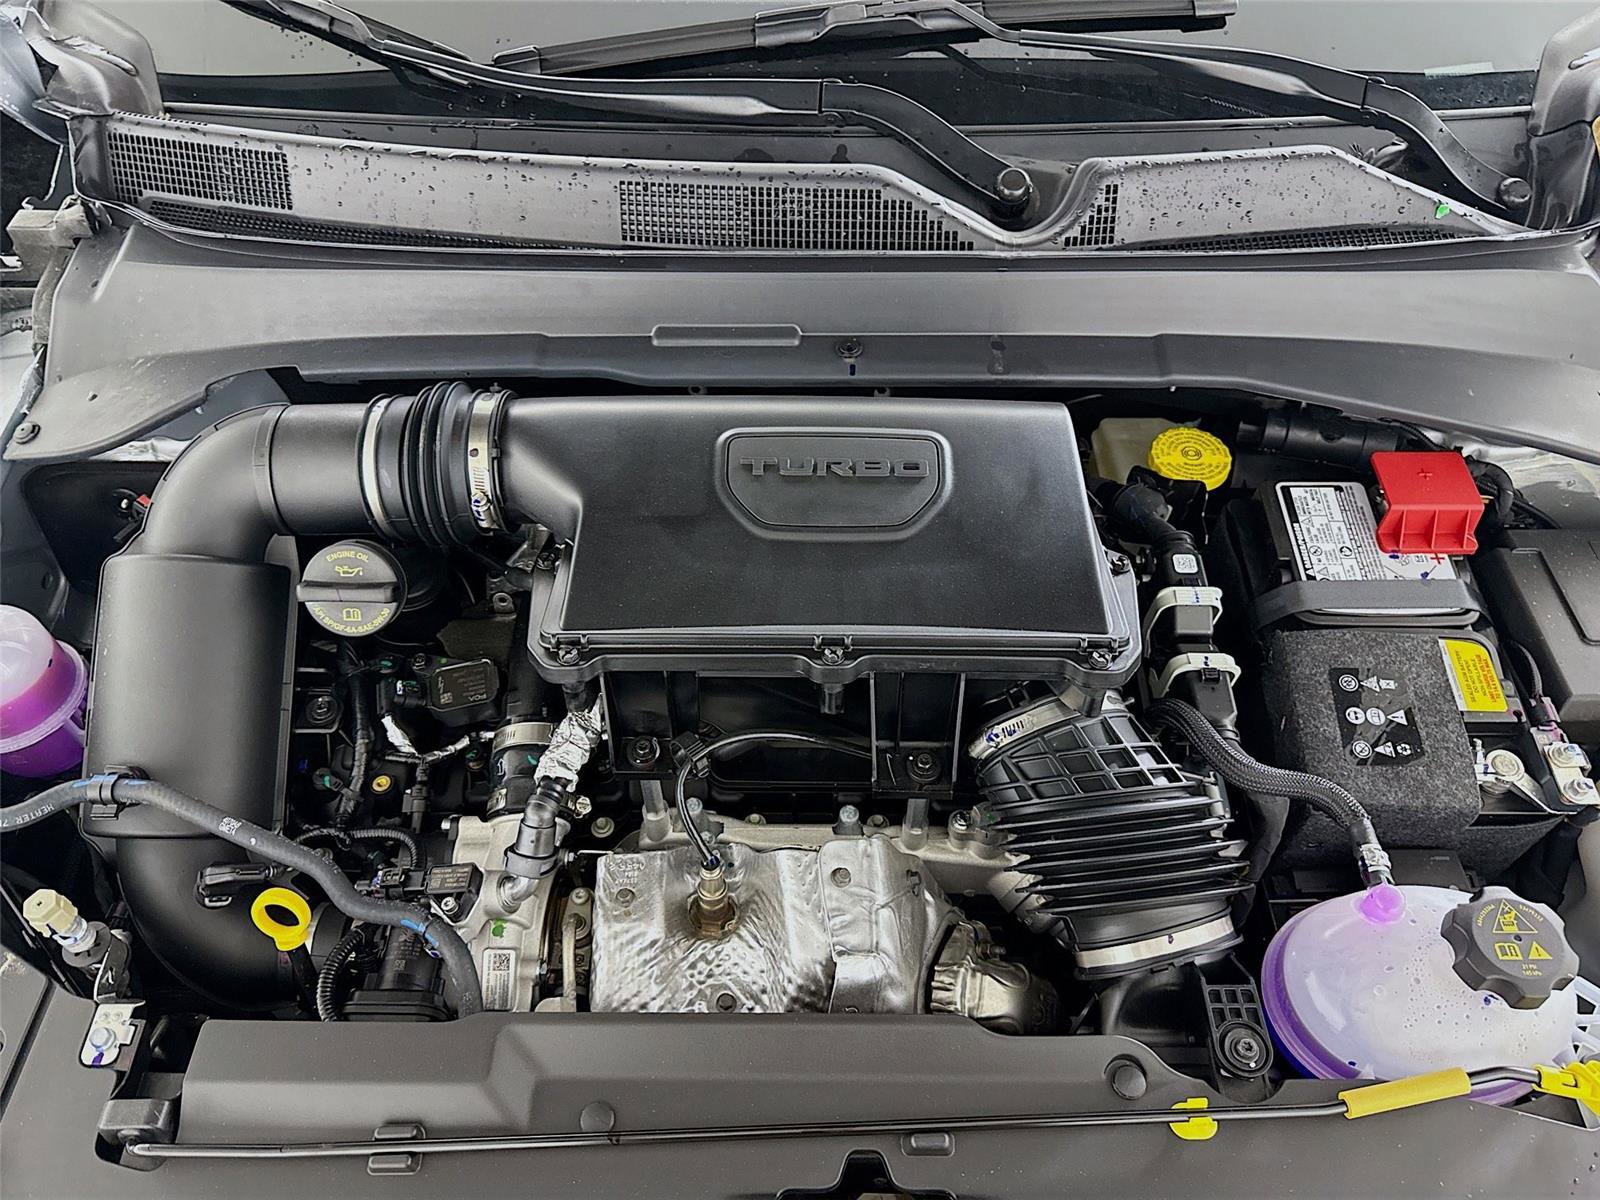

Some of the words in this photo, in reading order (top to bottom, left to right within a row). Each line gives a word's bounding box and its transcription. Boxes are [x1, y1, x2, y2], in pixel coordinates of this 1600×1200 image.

[740, 456, 929, 477] TURBO
[326, 550, 356, 562] ENGINE
[356, 552, 369, 562] OIL
[16, 803, 55, 825] HEATER
